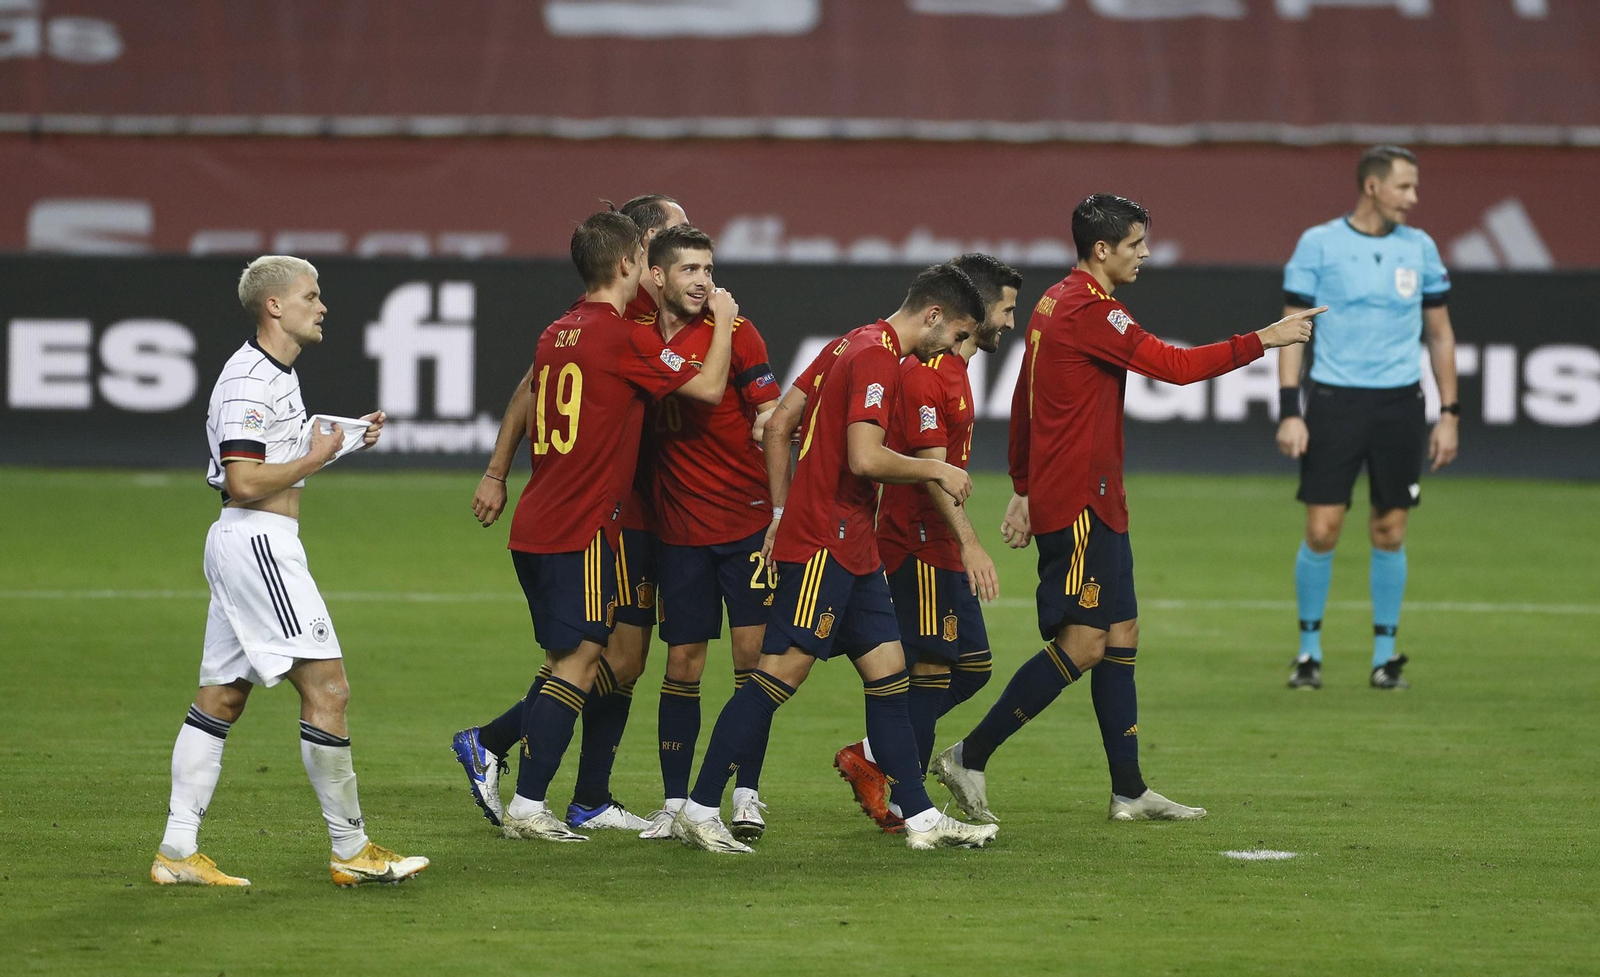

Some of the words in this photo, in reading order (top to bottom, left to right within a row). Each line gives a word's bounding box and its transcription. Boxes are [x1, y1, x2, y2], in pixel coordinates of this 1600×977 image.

[7, 317, 199, 413] ES
[554, 328, 582, 348] OLMO
[1029, 328, 1042, 420] 7
[533, 361, 583, 455] 19
